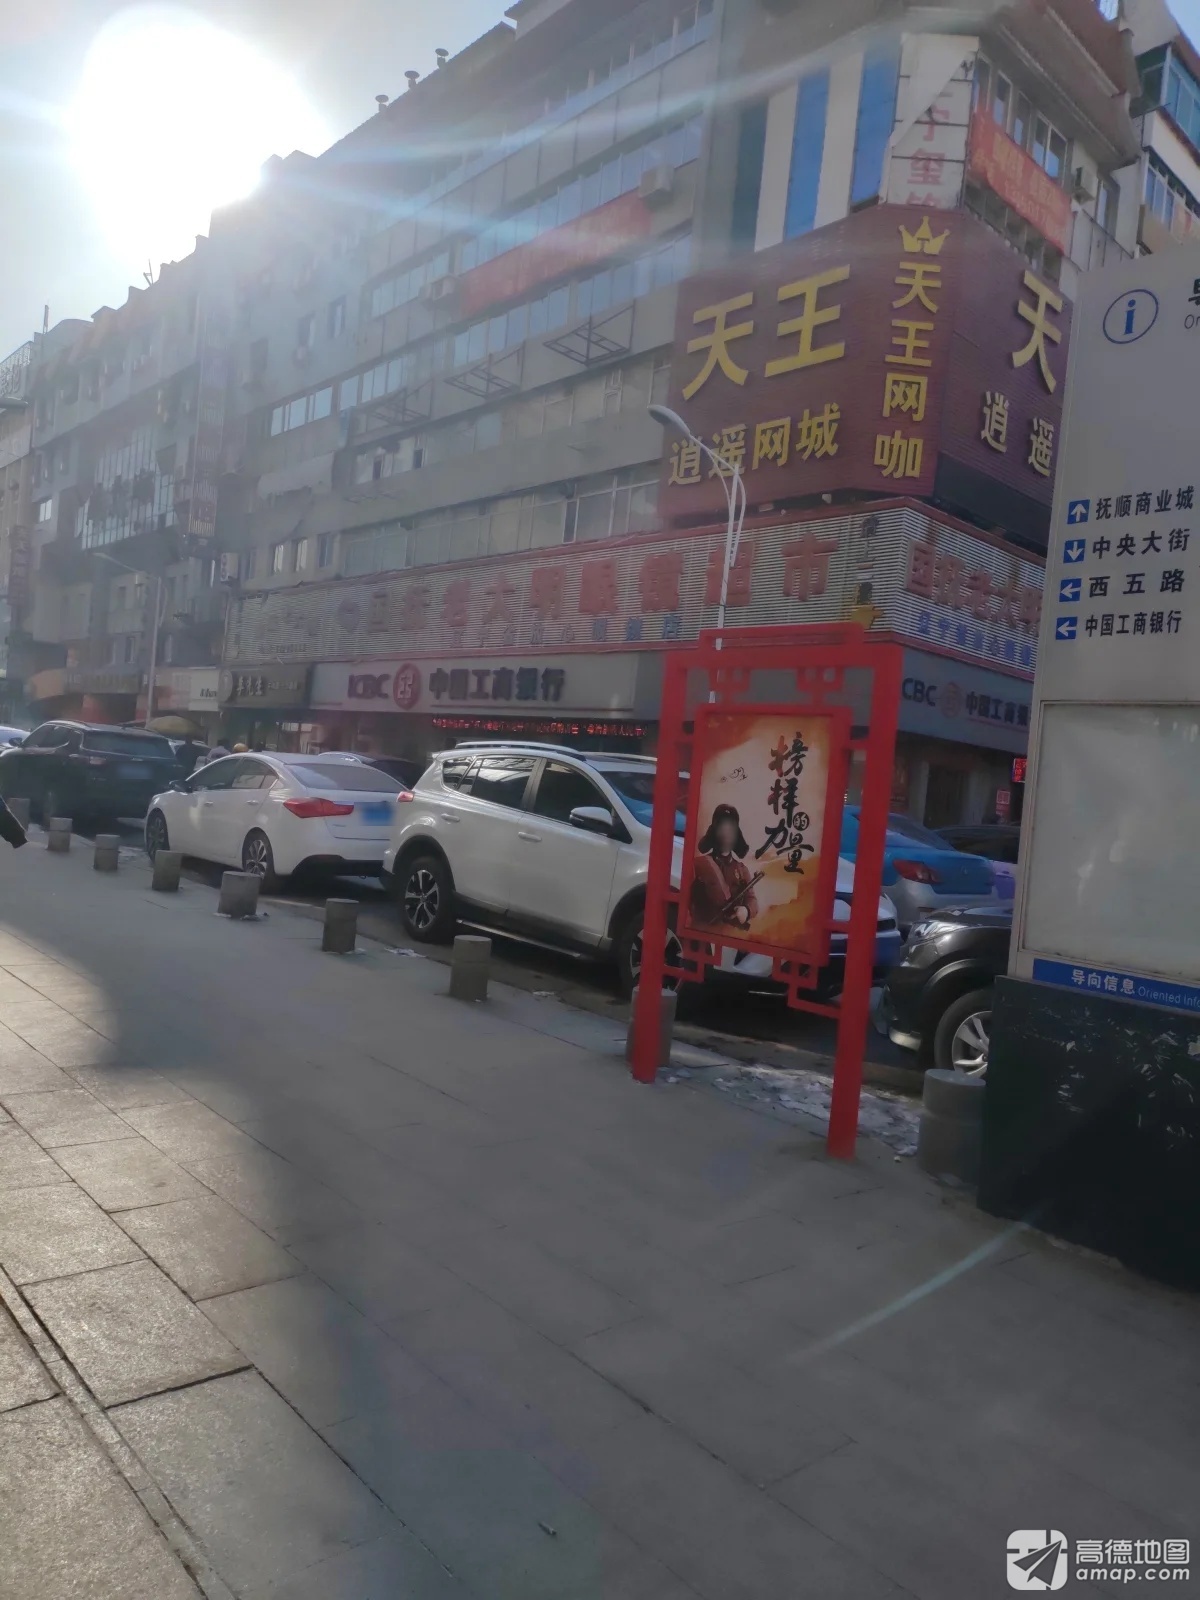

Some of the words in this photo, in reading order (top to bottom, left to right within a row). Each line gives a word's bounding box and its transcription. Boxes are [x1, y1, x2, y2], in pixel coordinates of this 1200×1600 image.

[682, 264, 850, 401] 天王
[1012, 269, 1063, 394] 天
[873, 262, 942, 480] 天王网咖
[668, 402, 841, 487] 逍遥网城
[981, 391, 1054, 477] 逍遥
[1095, 485, 1195, 521] 抚顺商业城
[1092, 528, 1191, 560] 中央大街
[1088, 568, 1186, 598] 西五路
[1085, 609, 1182, 638] 中国工商银行
[429, 666, 566, 702] 中国工商银行
[902, 677, 938, 707] CBC
[1071, 968, 1136, 995] 导向信息
[1138, 986, 1181, 1004] Oriented
